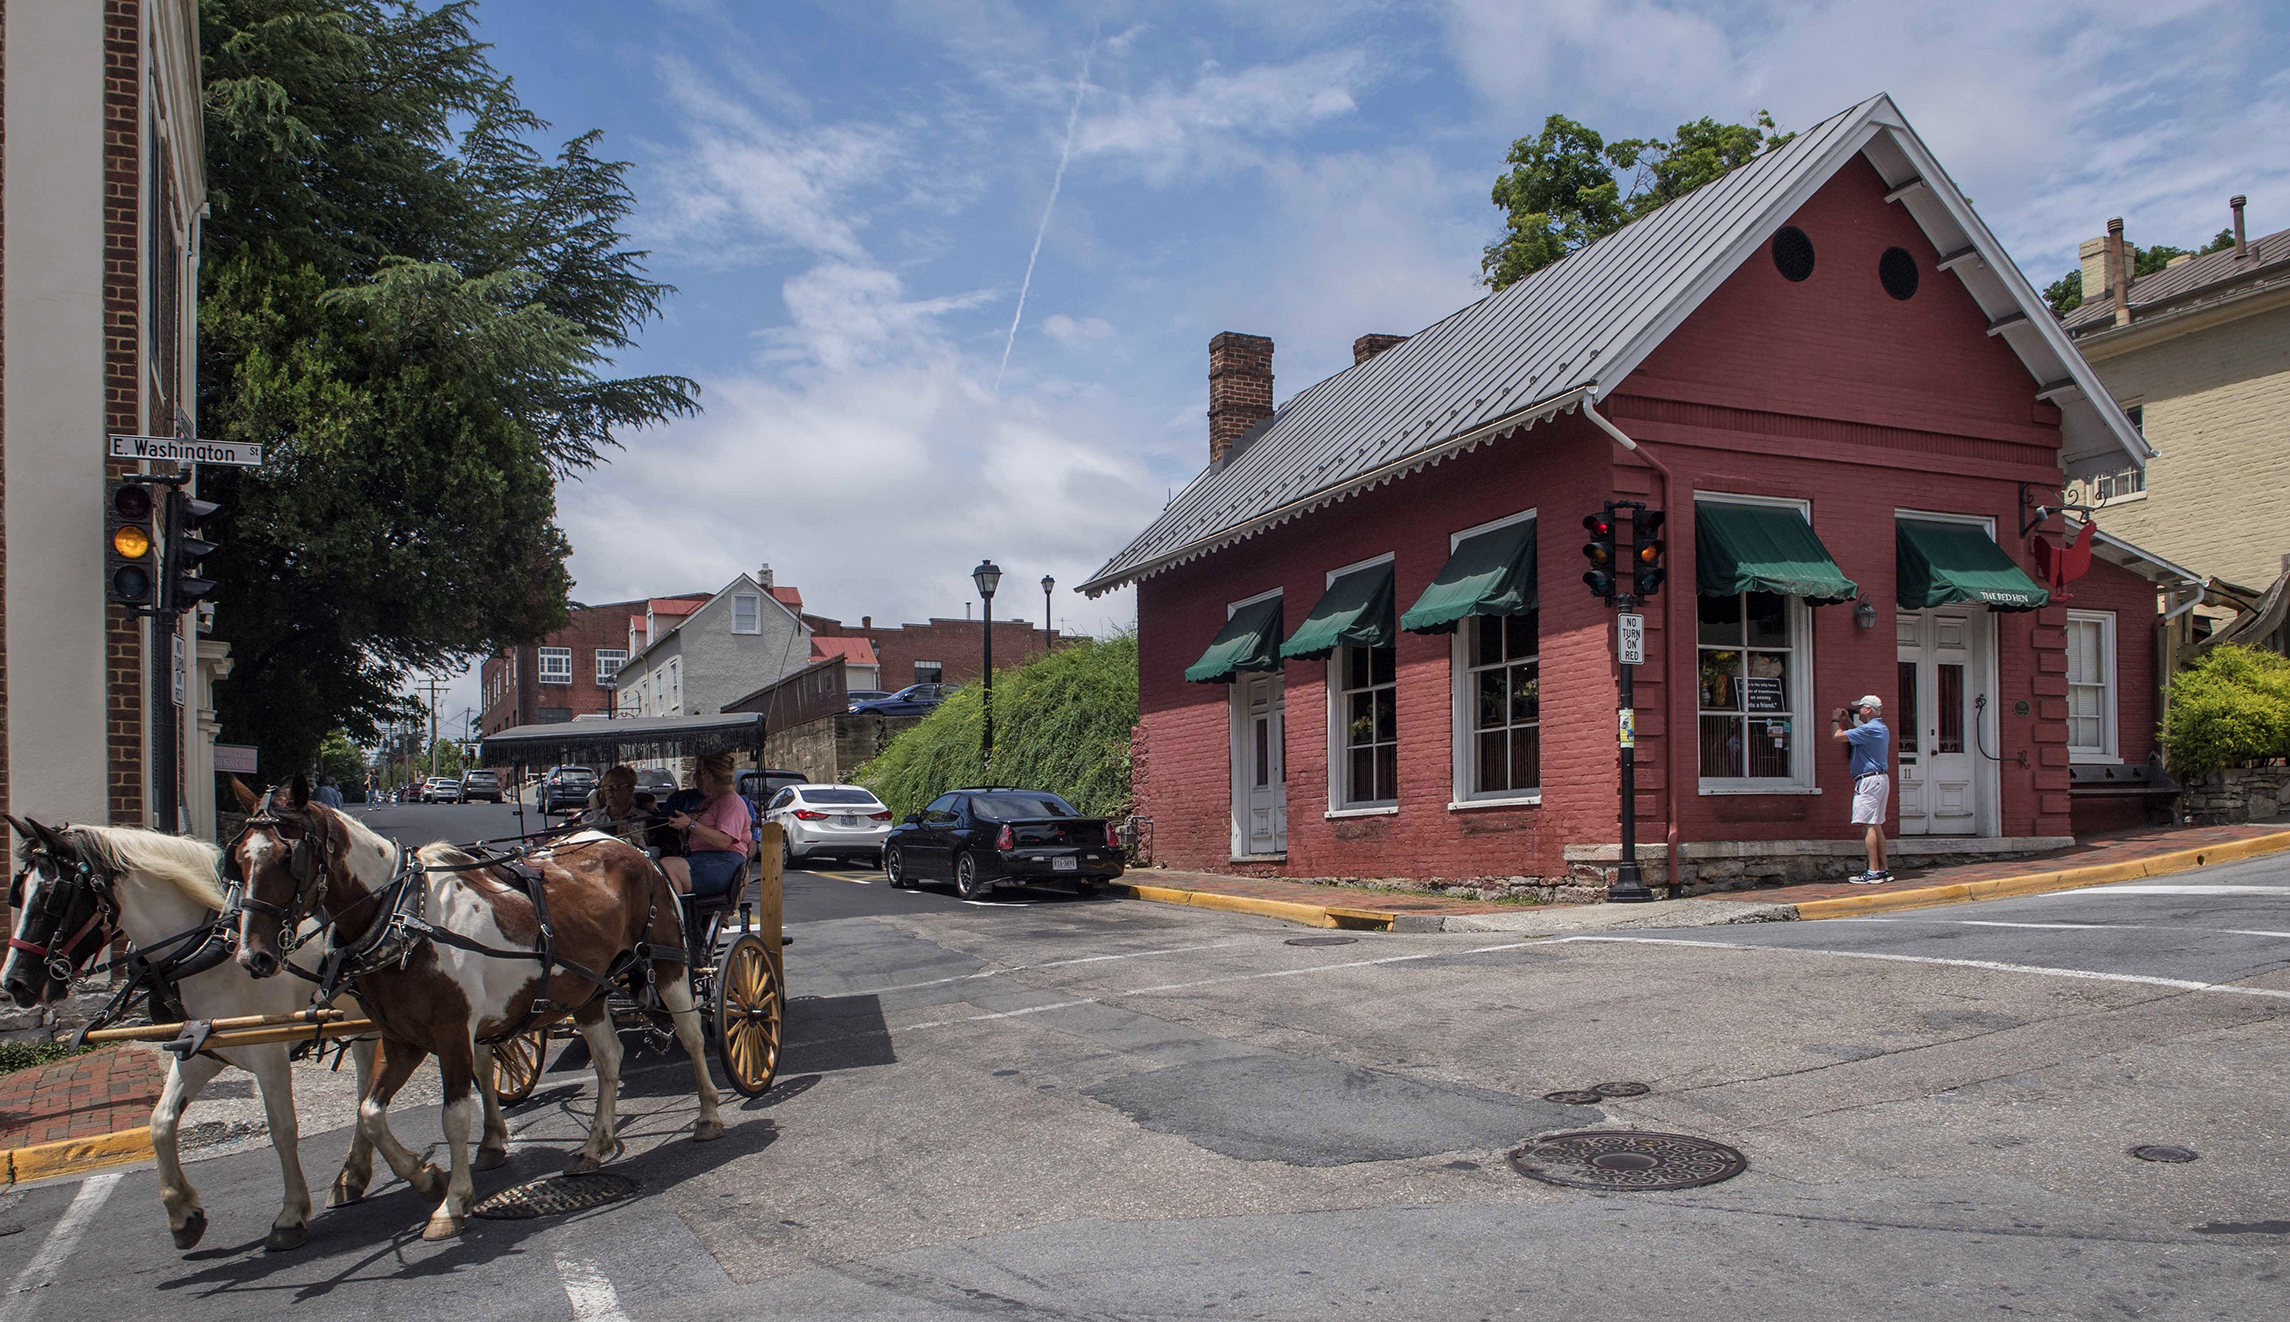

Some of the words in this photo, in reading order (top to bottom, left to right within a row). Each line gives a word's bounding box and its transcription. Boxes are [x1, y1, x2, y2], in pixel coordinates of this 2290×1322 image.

[113, 438, 128, 455] E.
[134, 439, 235, 462] Washington
[249, 446, 259, 456] St
[1980, 592, 1997, 600] THE
[1997, 592, 2012, 601] RED
[2012, 594, 2029, 602] HEN
[1627, 618, 1636, 627] NO
[1622, 628, 1641, 638] TURN
[1627, 640, 1636, 649] ON
[1626, 651, 1638, 660] RED
[1903, 768, 1911, 779] 11
